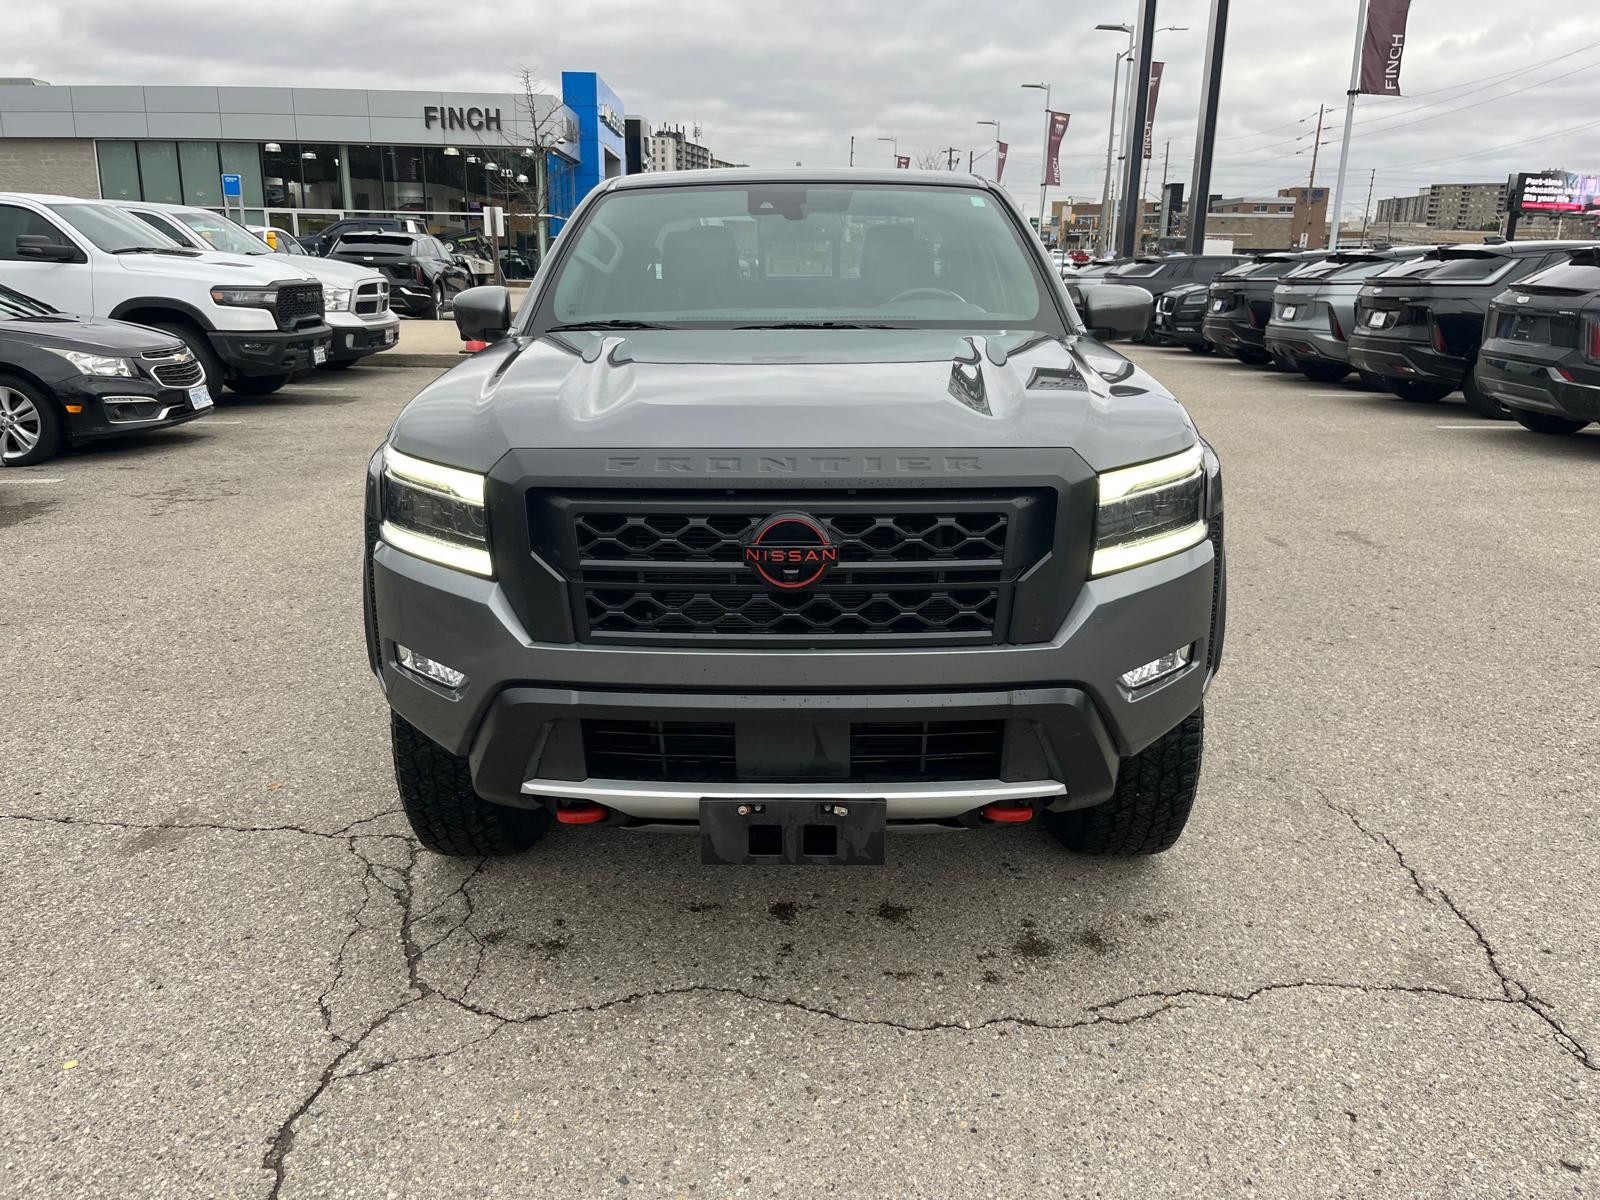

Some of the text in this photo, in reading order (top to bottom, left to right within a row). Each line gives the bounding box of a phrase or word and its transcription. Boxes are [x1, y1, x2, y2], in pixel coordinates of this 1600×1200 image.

[1385, 34, 1404, 90] FINCH
[424, 106, 501, 131] FINCH
[1143, 121, 1151, 155] FINCH
[1052, 158, 1060, 182] FINCH
[1524, 186, 1563, 194] education
[1525, 177, 1563, 186] Part-time
[1523, 194, 1570, 203] fits your life
[605, 456, 984, 473] FRONTIER
[745, 548, 837, 563] NISSAN
